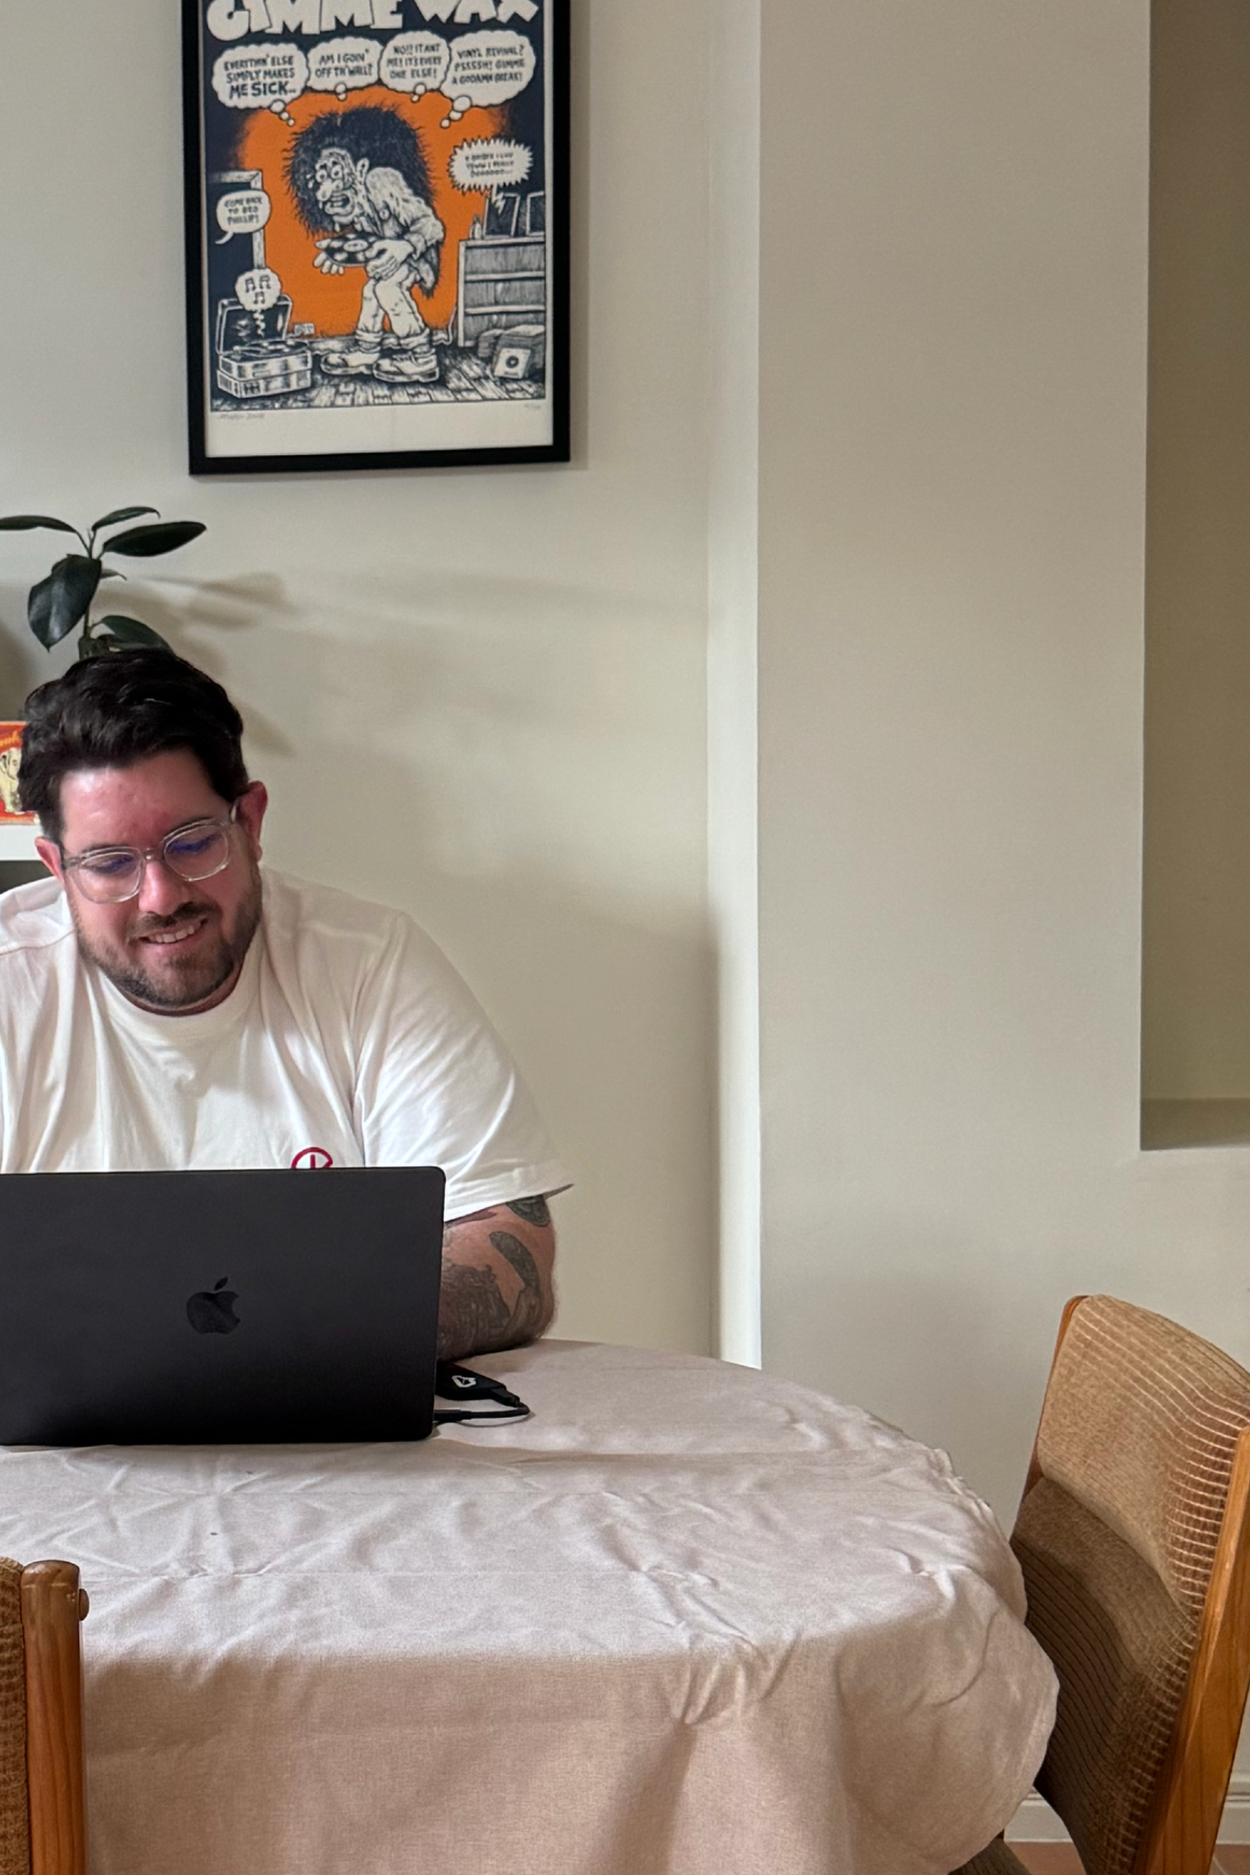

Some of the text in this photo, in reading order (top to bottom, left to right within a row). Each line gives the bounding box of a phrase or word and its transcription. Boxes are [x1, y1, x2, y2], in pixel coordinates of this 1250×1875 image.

[457, 48, 482, 59] VINYL
[271, 56, 294, 66] ELSE
[319, 54, 334, 65] AM
[226, 68, 295, 84] SIMPLY MAKES
[314, 67, 331, 78] OFF
[229, 84, 248, 100] ME
